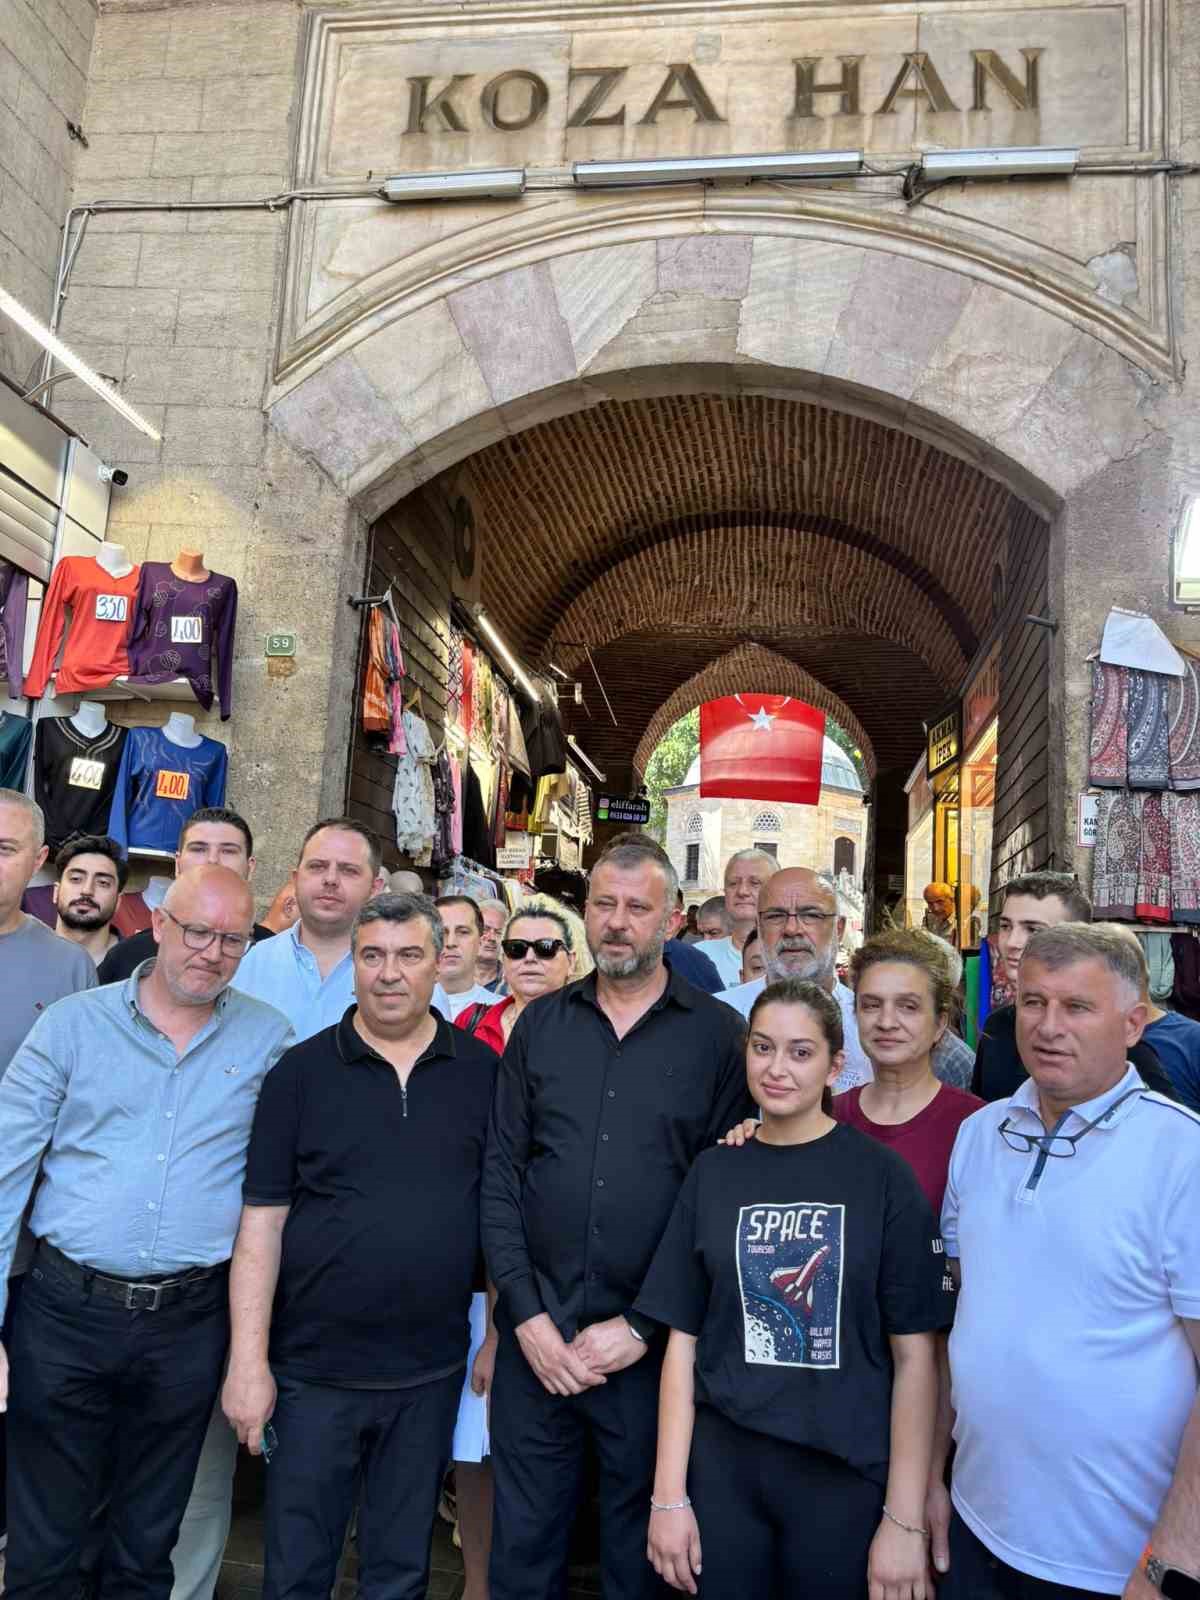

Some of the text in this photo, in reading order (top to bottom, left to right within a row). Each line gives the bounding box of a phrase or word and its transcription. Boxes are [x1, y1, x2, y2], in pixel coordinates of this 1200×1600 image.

[401, 47, 1046, 135] KOZA HAN
[97, 595, 126, 620] 350
[272, 638, 289, 648] 59
[747, 1209, 828, 1242] SPACE
